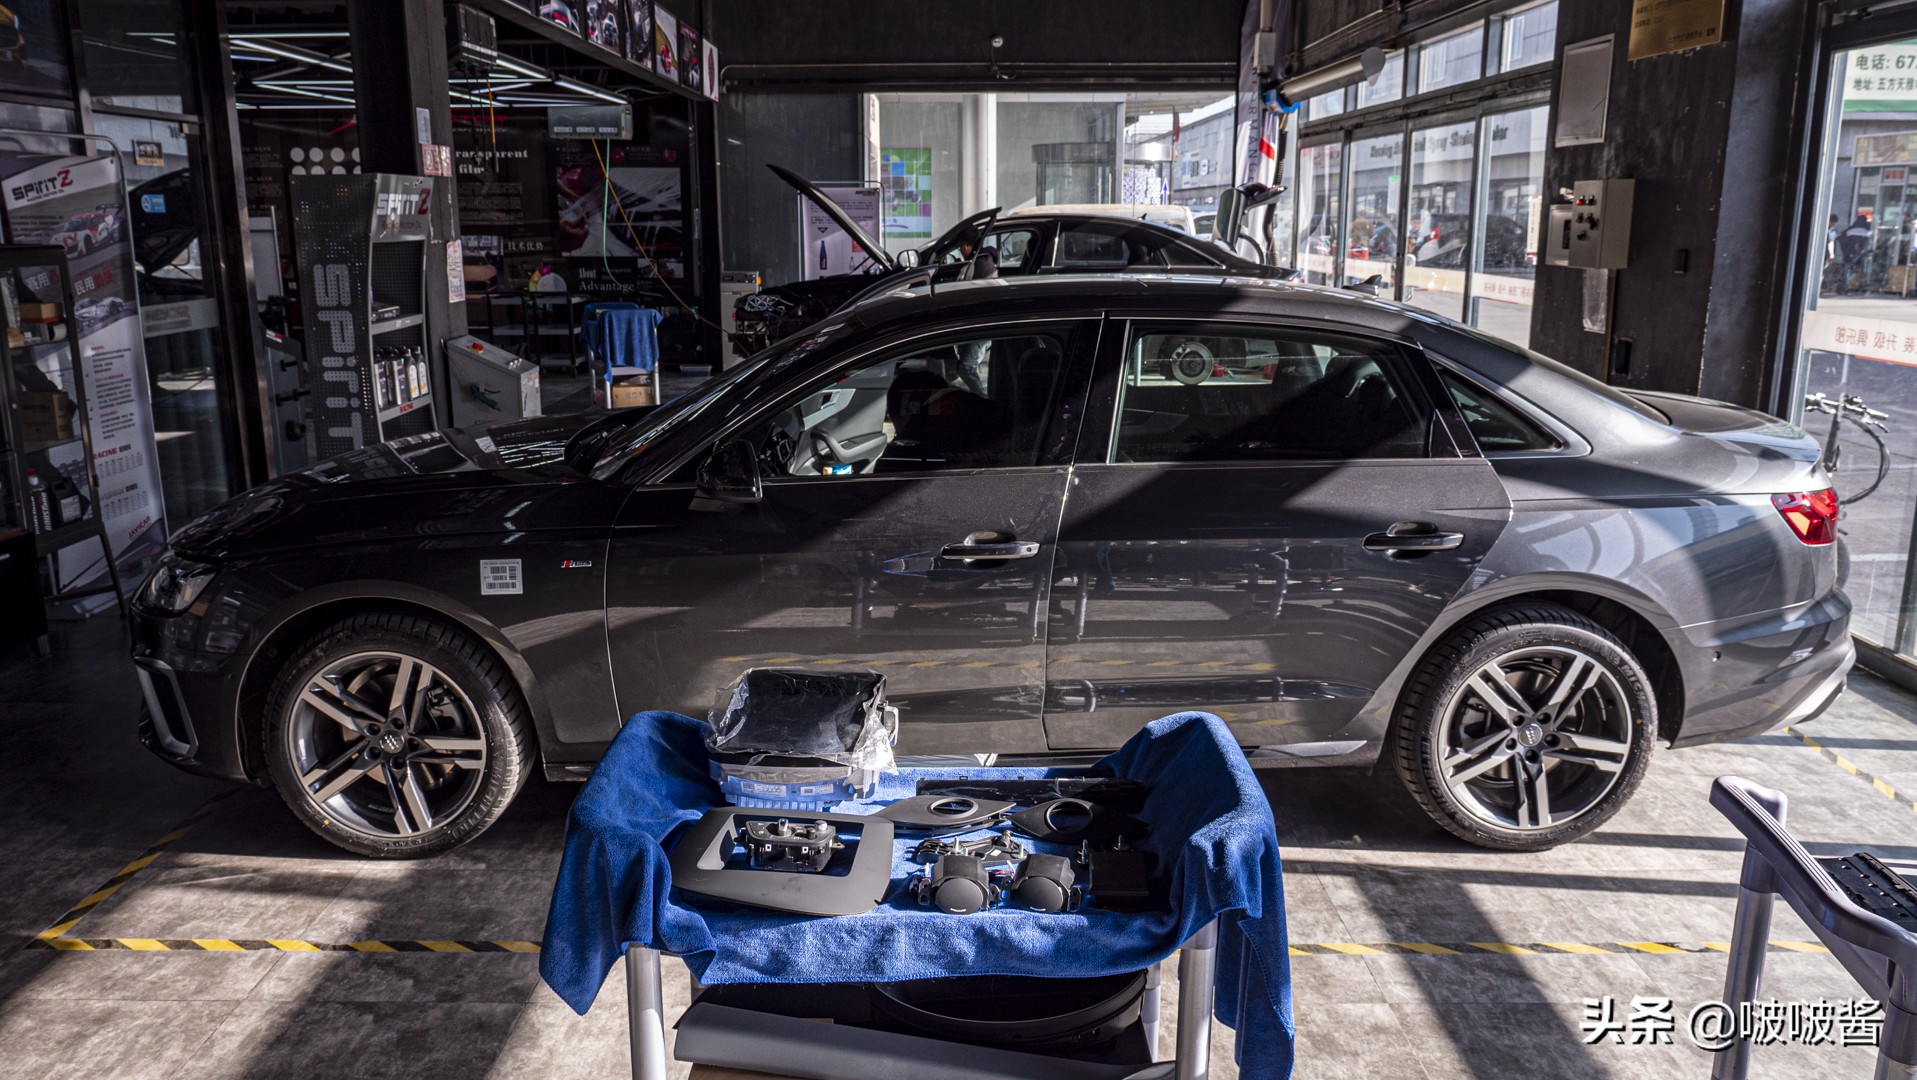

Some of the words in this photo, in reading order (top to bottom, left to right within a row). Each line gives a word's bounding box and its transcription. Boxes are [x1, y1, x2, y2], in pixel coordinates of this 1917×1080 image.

[1856, 53, 1890, 70] 电话:
[1896, 55, 1917, 69] 67
[455, 149, 528, 161] ransparent
[508, 241, 544, 251] 技术优势
[579, 281, 635, 293] Advantage
[400, 403, 414, 414] RACING
